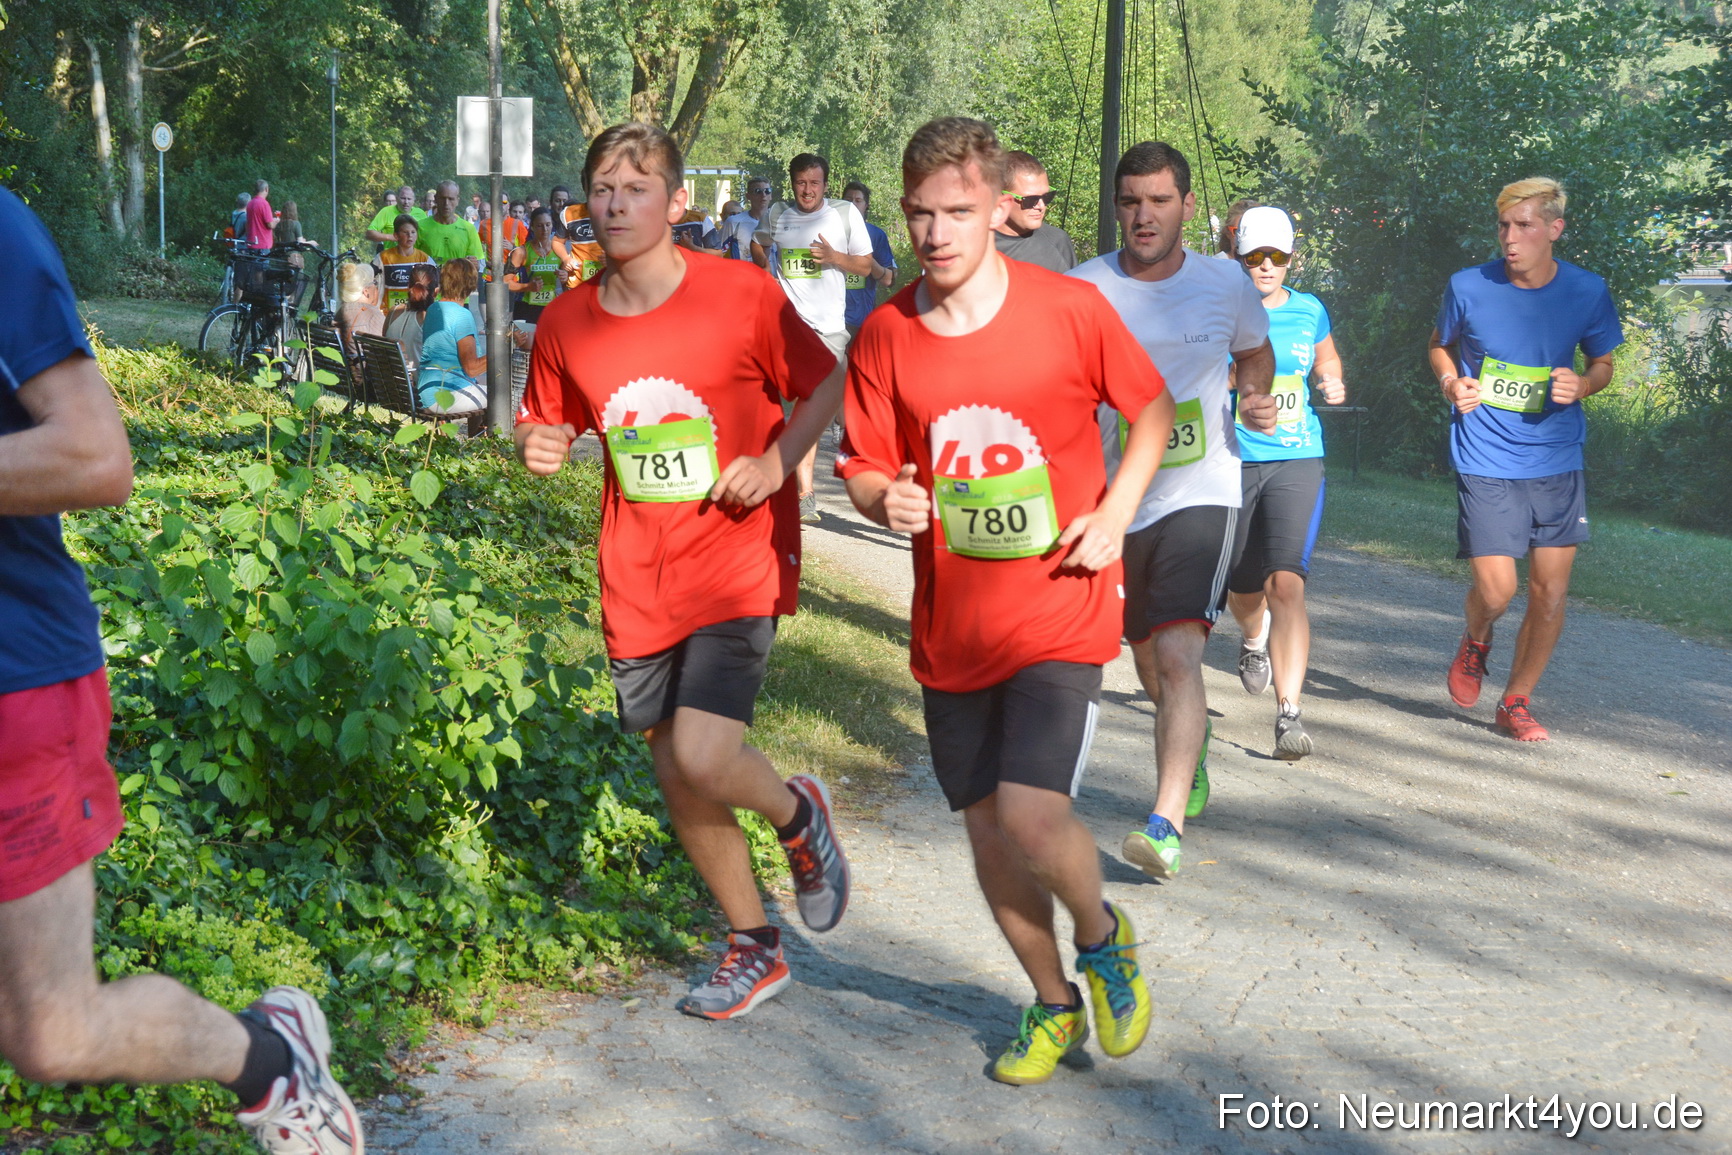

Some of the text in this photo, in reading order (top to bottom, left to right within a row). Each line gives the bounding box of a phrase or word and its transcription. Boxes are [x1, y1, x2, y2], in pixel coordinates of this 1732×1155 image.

[786, 259, 816, 270] 1148
[588, 268, 599, 276] 60
[845, 275, 860, 284] 53
[535, 291, 550, 300] 212
[394, 298, 408, 306] 59
[1184, 333, 1210, 344] Luca
[1493, 378, 1532, 399] 660
[1275, 392, 1297, 410] 00
[1166, 423, 1195, 450] 93
[631, 451, 688, 480] 781
[636, 479, 698, 489] Schmitz Michael
[961, 504, 1028, 536] 780
[967, 534, 1032, 545] Schmitz Marco
